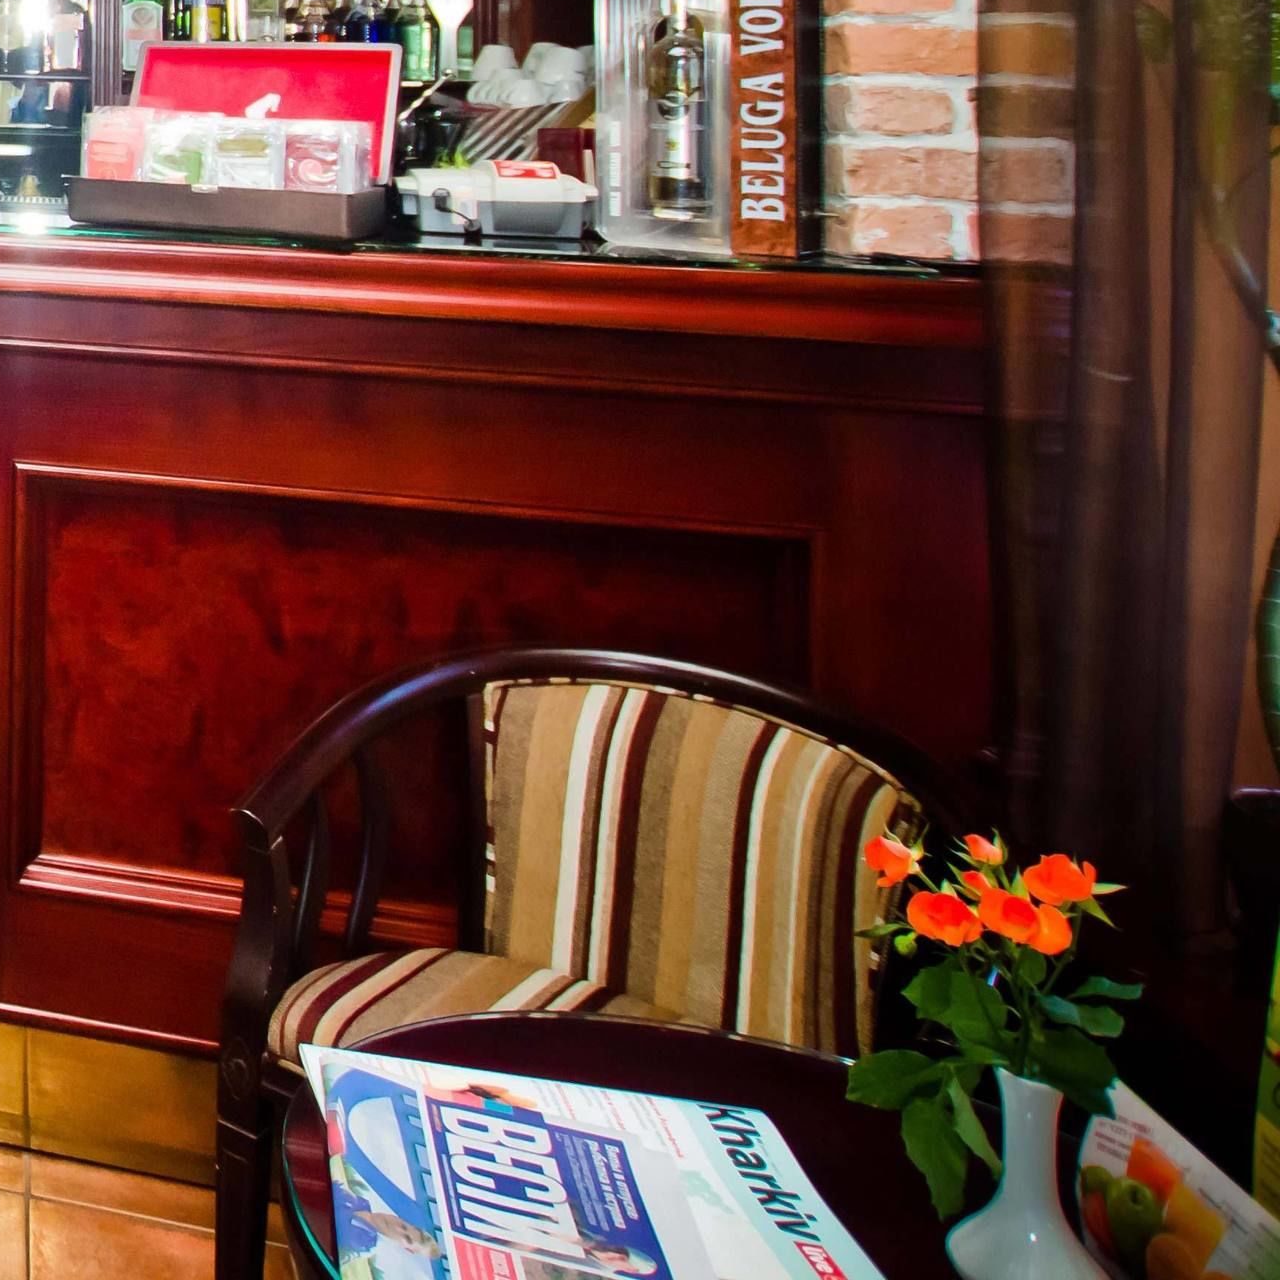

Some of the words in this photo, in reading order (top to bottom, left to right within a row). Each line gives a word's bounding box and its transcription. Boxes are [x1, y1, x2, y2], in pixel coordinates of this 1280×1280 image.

[741, 72, 785, 222] BELUGA
[439, 1105, 586, 1259] ВЕСТИ
[698, 1103, 822, 1243] Kharkiv
